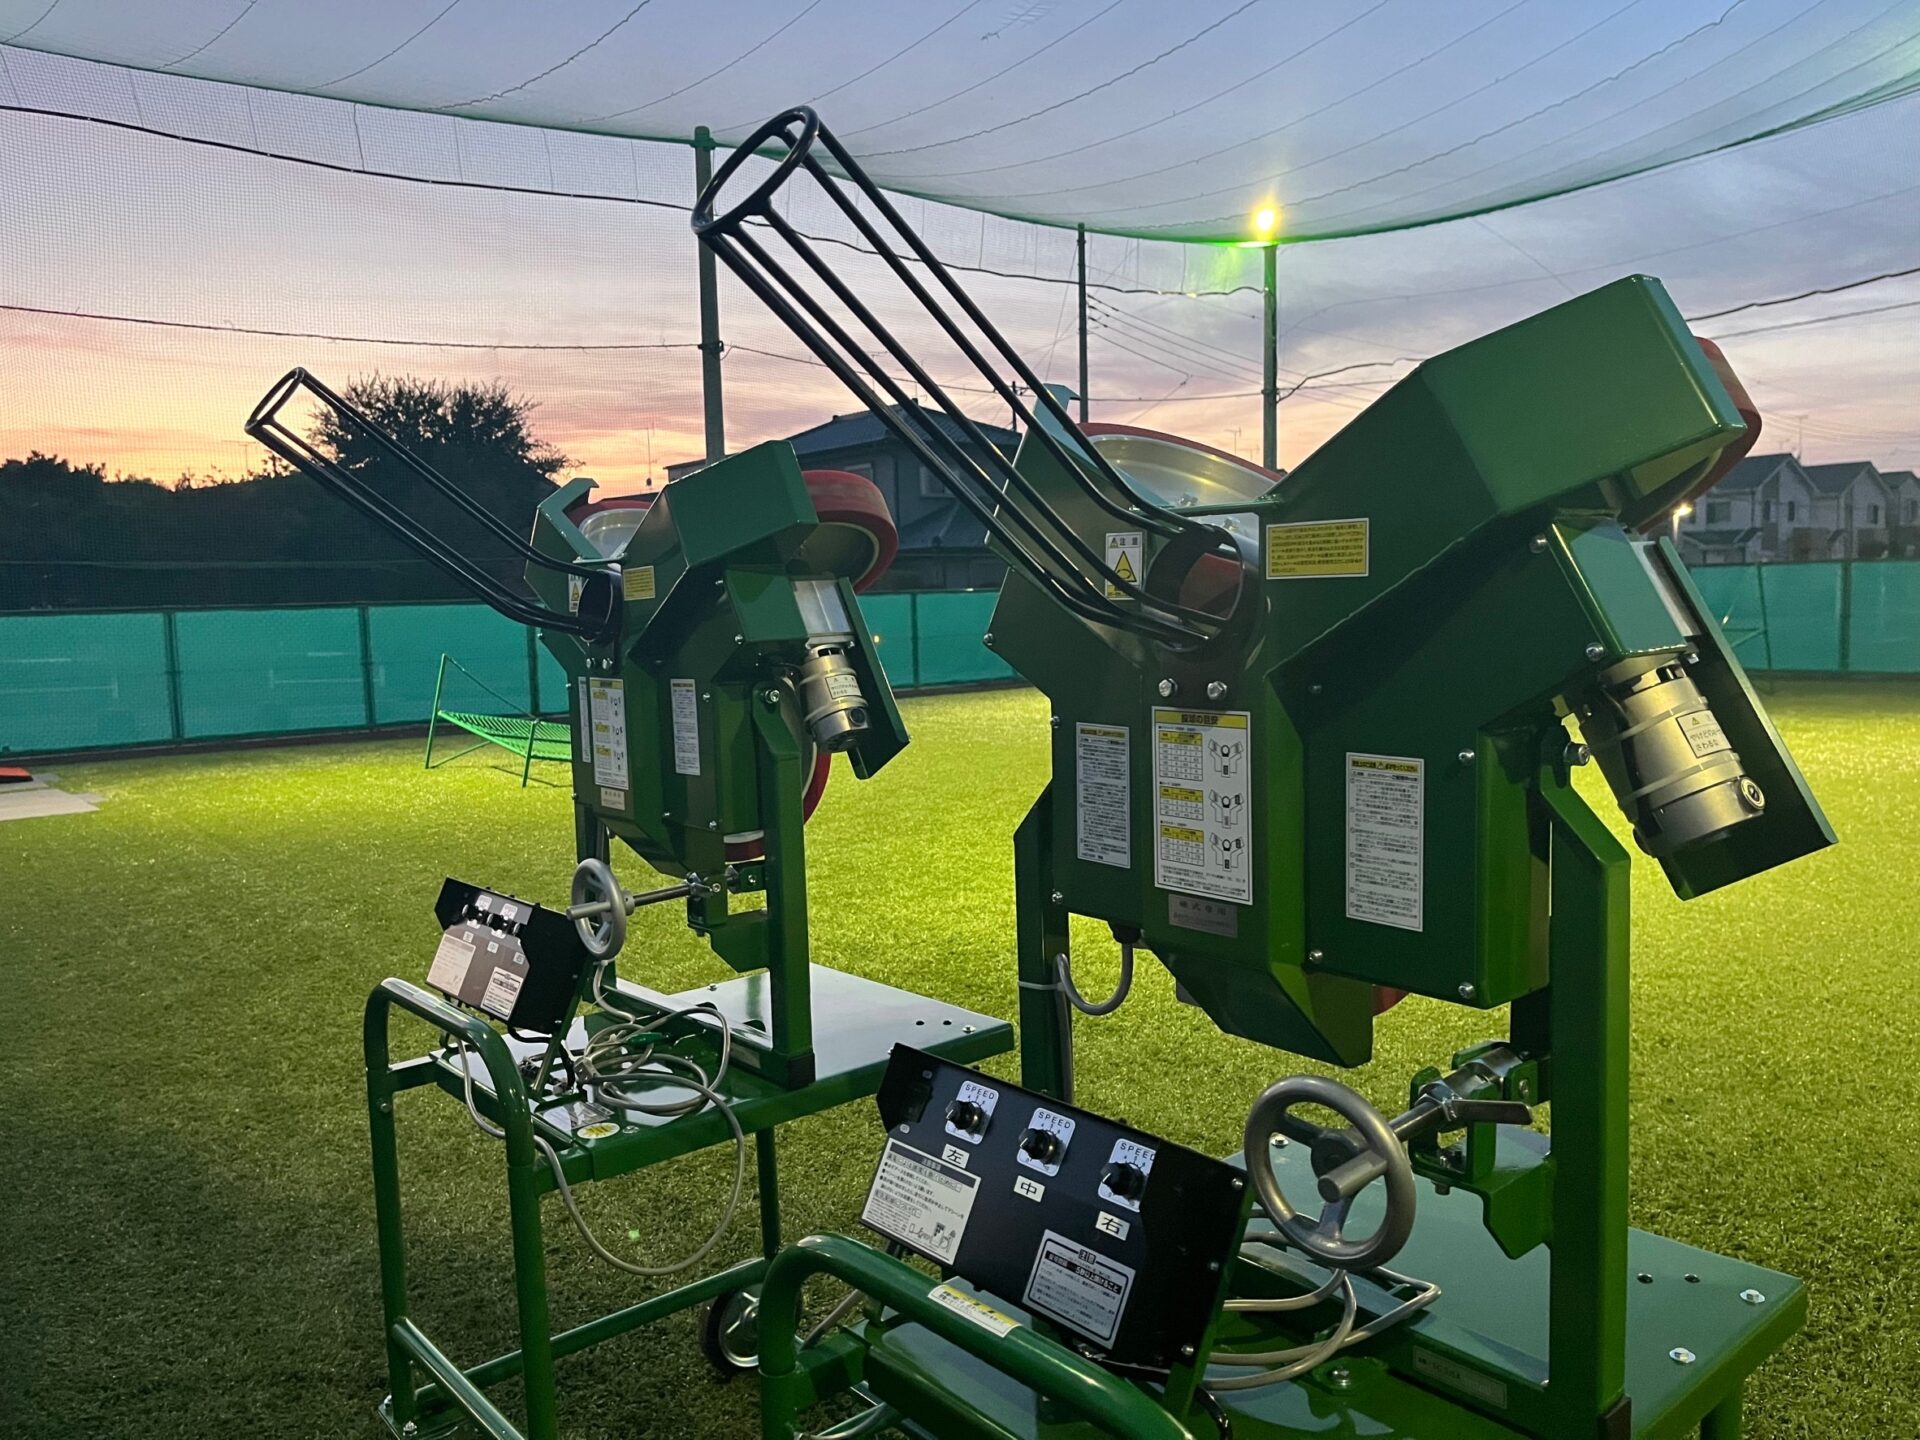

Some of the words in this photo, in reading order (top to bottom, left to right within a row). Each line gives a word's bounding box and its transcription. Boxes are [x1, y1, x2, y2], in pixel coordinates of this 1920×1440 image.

[965, 1084, 995, 1100] SPEED
[1038, 1111, 1071, 1129] SPEED
[947, 1149, 964, 1165] 左
[1020, 1181, 1038, 1196] 中
[1101, 1216, 1124, 1235] 右
